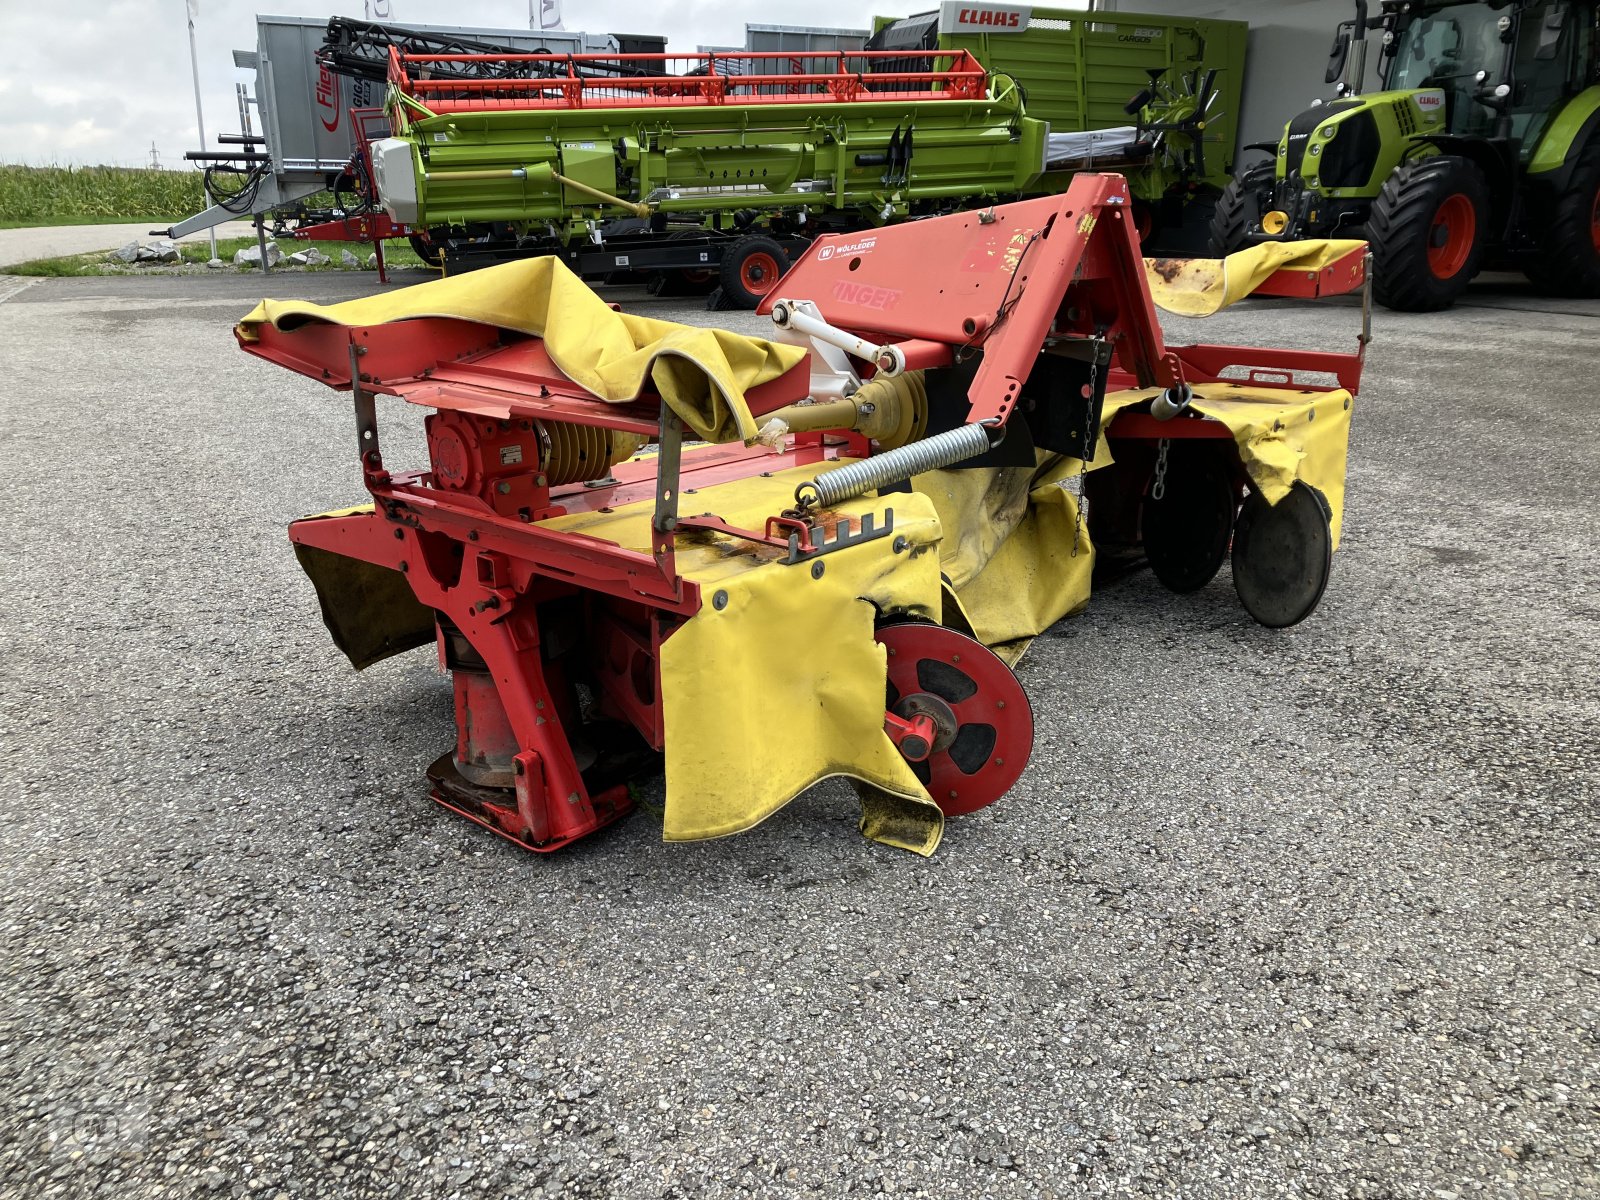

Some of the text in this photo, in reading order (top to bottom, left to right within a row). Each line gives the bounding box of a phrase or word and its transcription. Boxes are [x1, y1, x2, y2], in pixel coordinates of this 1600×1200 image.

[959, 9, 1020, 27] CLAAS
[1118, 34, 1152, 43] CARGOS
[1419, 96, 1440, 106] CLAAS
[836, 241, 876, 253] WÖLFLEDER
